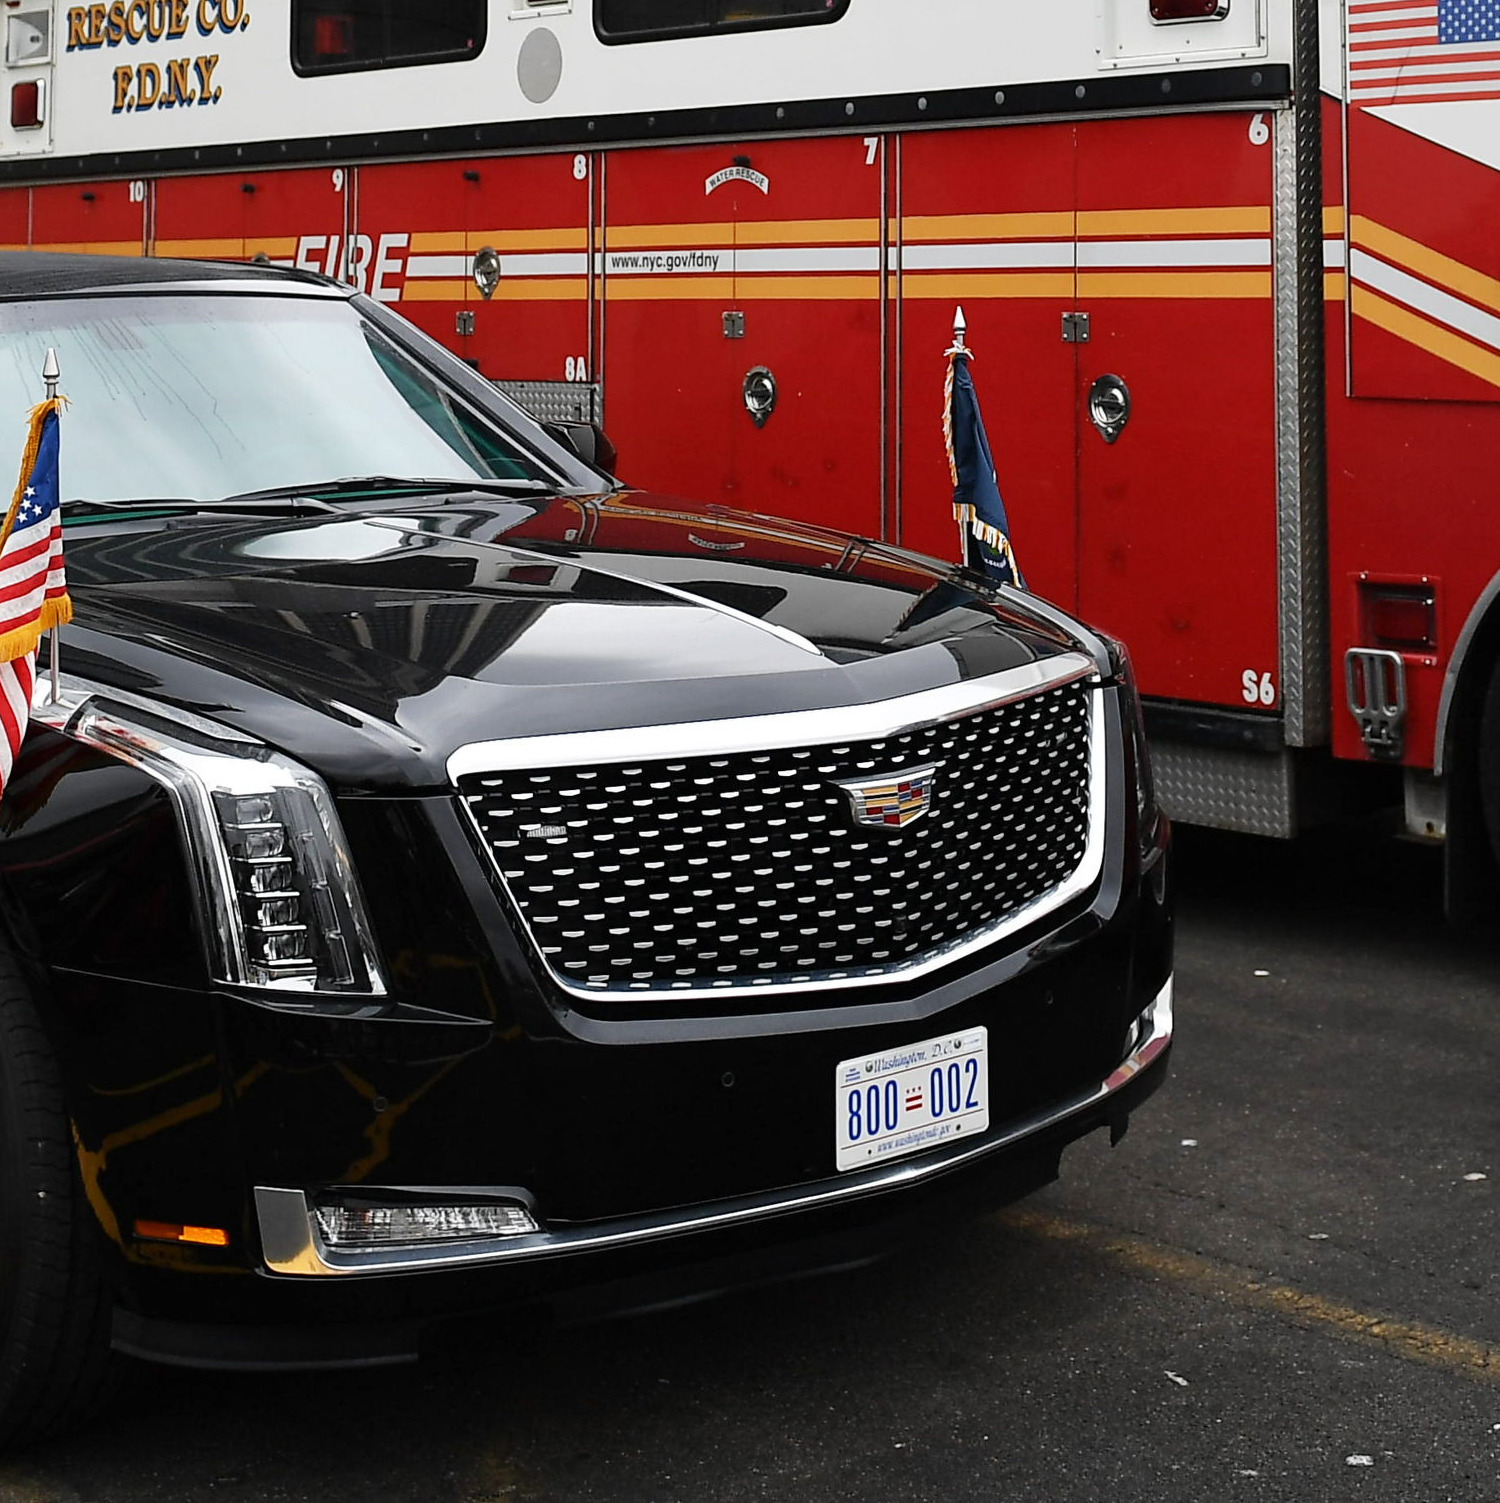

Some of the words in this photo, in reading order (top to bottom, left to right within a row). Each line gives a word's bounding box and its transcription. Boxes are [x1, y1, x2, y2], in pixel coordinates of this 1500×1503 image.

[112, 54, 222, 114] F.D.N.Y.
[1248, 113, 1269, 145] 6
[863, 137, 878, 165] 7
[332, 168, 344, 192] 9
[573, 154, 587, 180] 8
[709, 169, 734, 187] WATER
[735, 168, 765, 187] RESCUE
[129, 181, 145, 202] 10
[296, 233, 409, 302] FIRE
[611, 252, 719, 271] www.nyc.gov/fdny
[565, 356, 587, 382] 8A
[1242, 669, 1275, 705] S6
[848, 1080, 898, 1141] 800
[930, 1058, 978, 1118] 002
